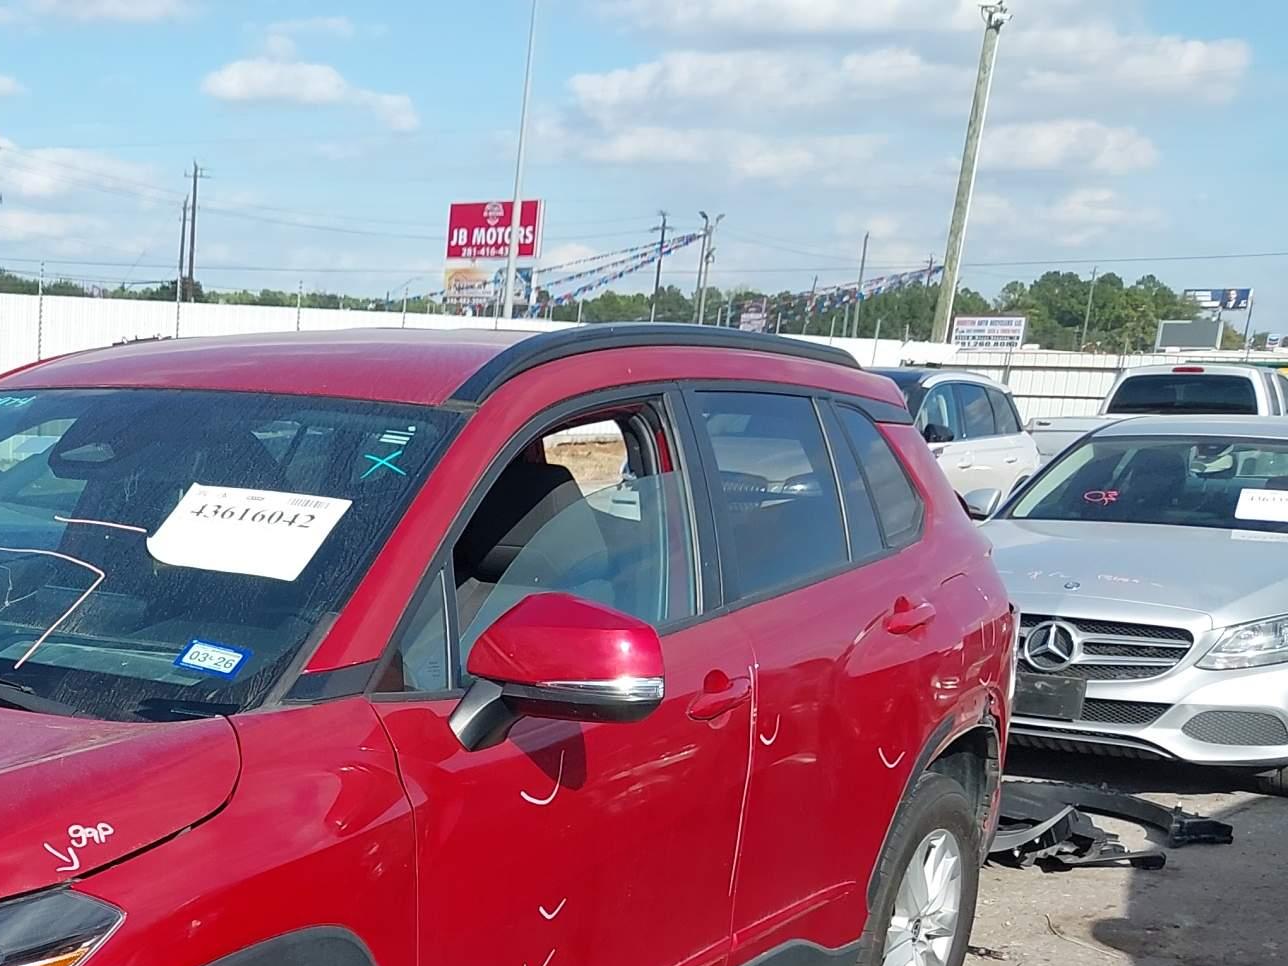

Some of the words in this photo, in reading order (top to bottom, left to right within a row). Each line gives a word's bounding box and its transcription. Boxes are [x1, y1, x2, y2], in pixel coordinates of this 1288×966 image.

[450, 228, 468, 246] JB
[190, 503, 316, 528] 43616042
[68, 822, 114, 848] gap
